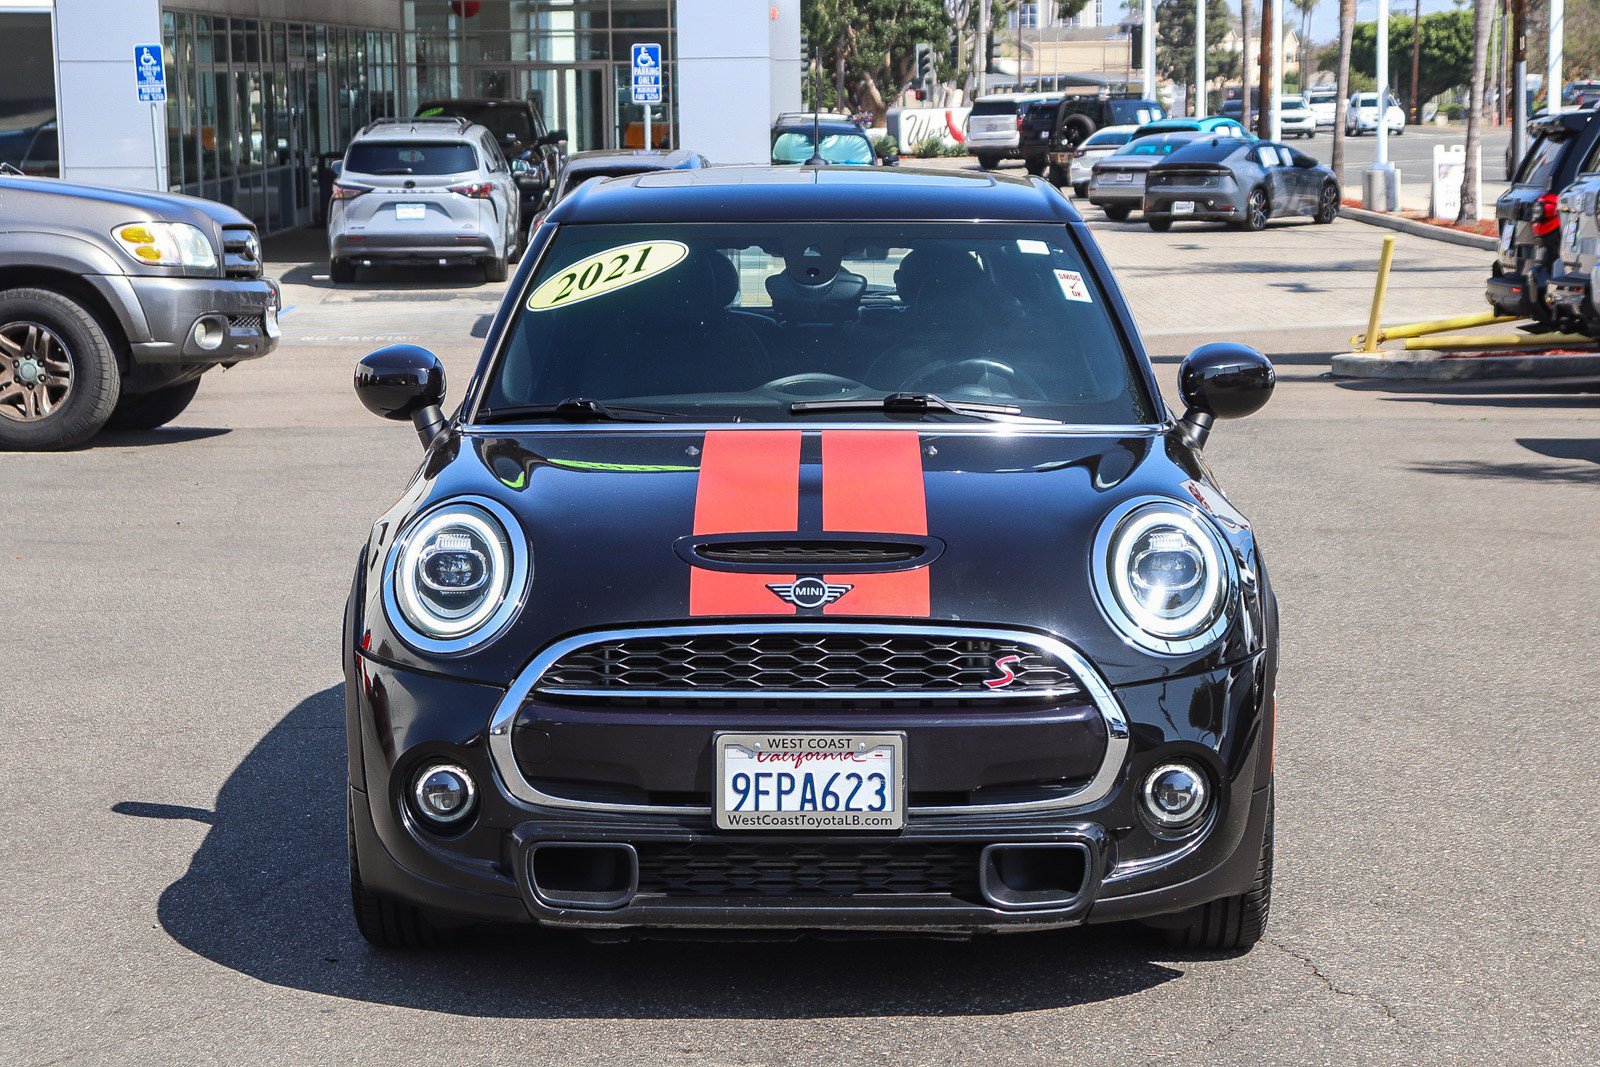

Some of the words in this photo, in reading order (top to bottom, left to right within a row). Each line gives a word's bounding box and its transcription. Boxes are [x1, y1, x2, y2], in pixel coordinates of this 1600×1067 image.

[633, 66, 660, 76] PARKING
[638, 75, 655, 85] ONLY
[551, 246, 653, 304] 2021
[795, 587, 823, 596] MINI
[983, 654, 1020, 688] S
[767, 738, 804, 749] WEST
[807, 738, 852, 749] COAST
[732, 772, 886, 811] 9FPA623
[727, 814, 892, 828] WestCoastToyotaLB.com
